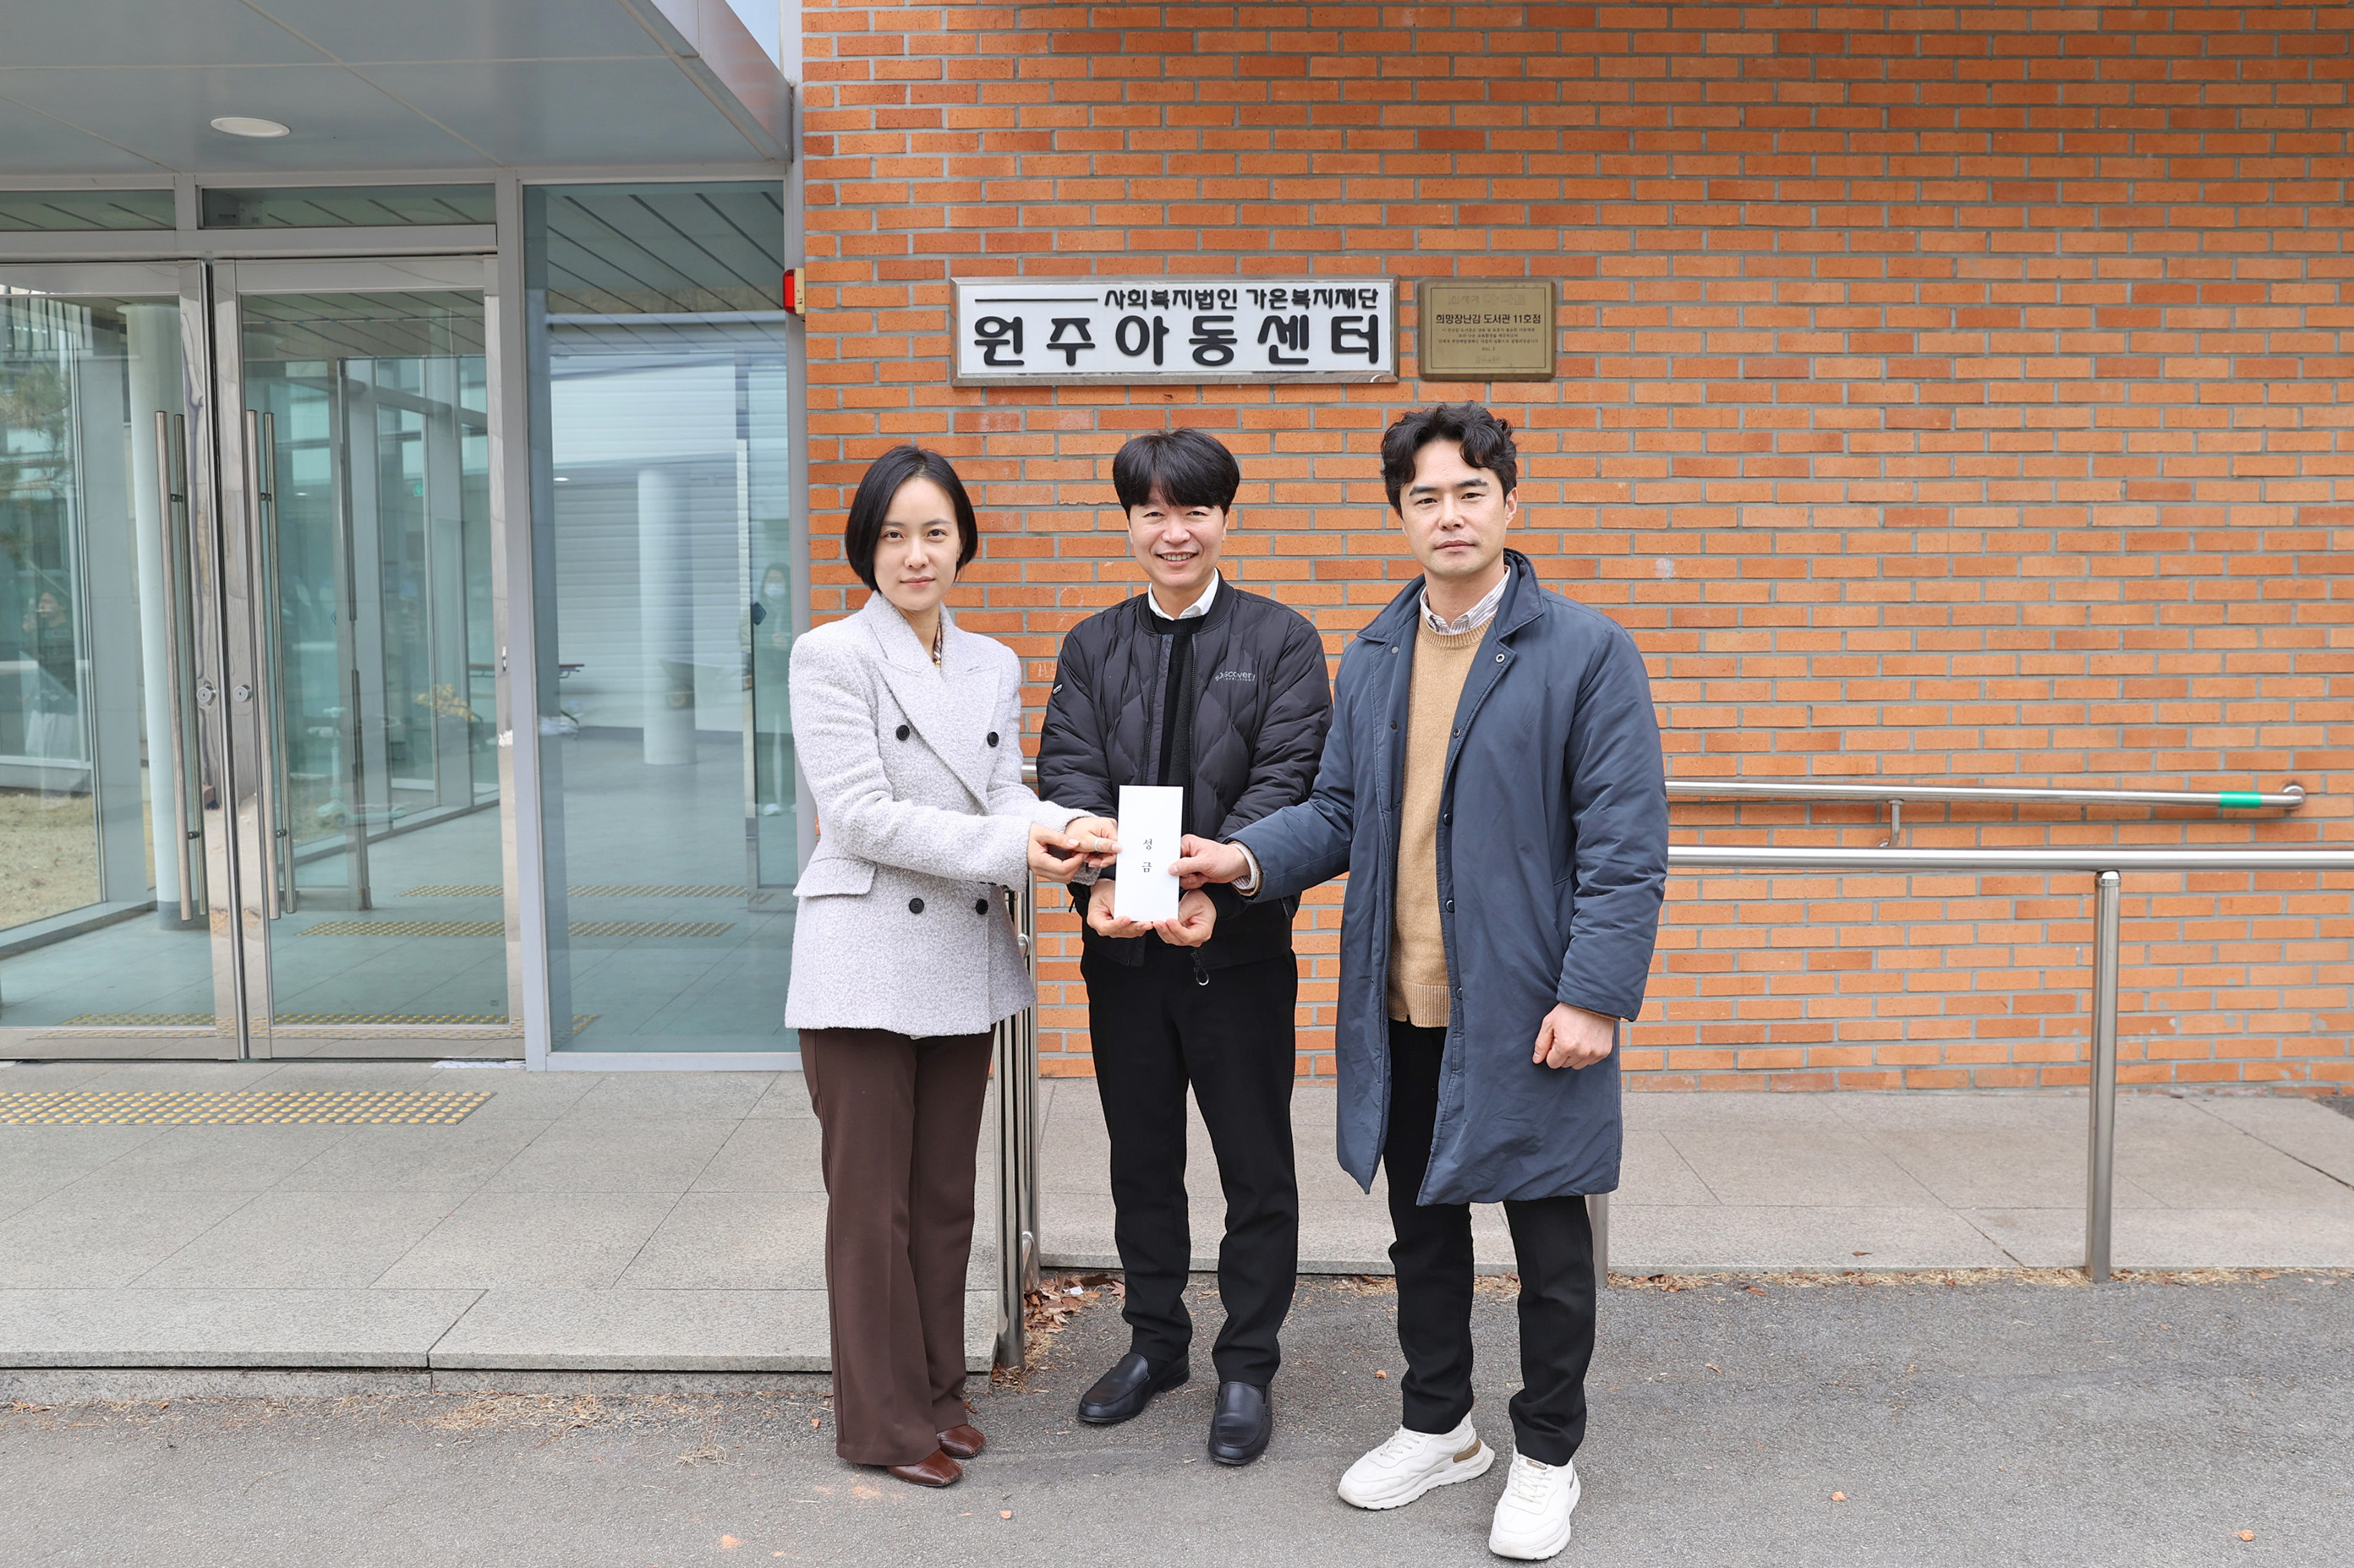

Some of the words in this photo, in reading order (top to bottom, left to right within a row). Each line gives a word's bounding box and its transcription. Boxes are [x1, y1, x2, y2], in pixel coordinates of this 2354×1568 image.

[1104, 288, 1238, 310] 사회복지법인
[1245, 288, 1379, 310] 가온복지재단
[1436, 314, 1481, 325] 희망장난감
[1483, 314, 1510, 325] 도서관
[1514, 314, 1541, 325] 11호점
[973, 314, 1379, 367] 원주아동센터
[1141, 839, 1152, 872] 성금
